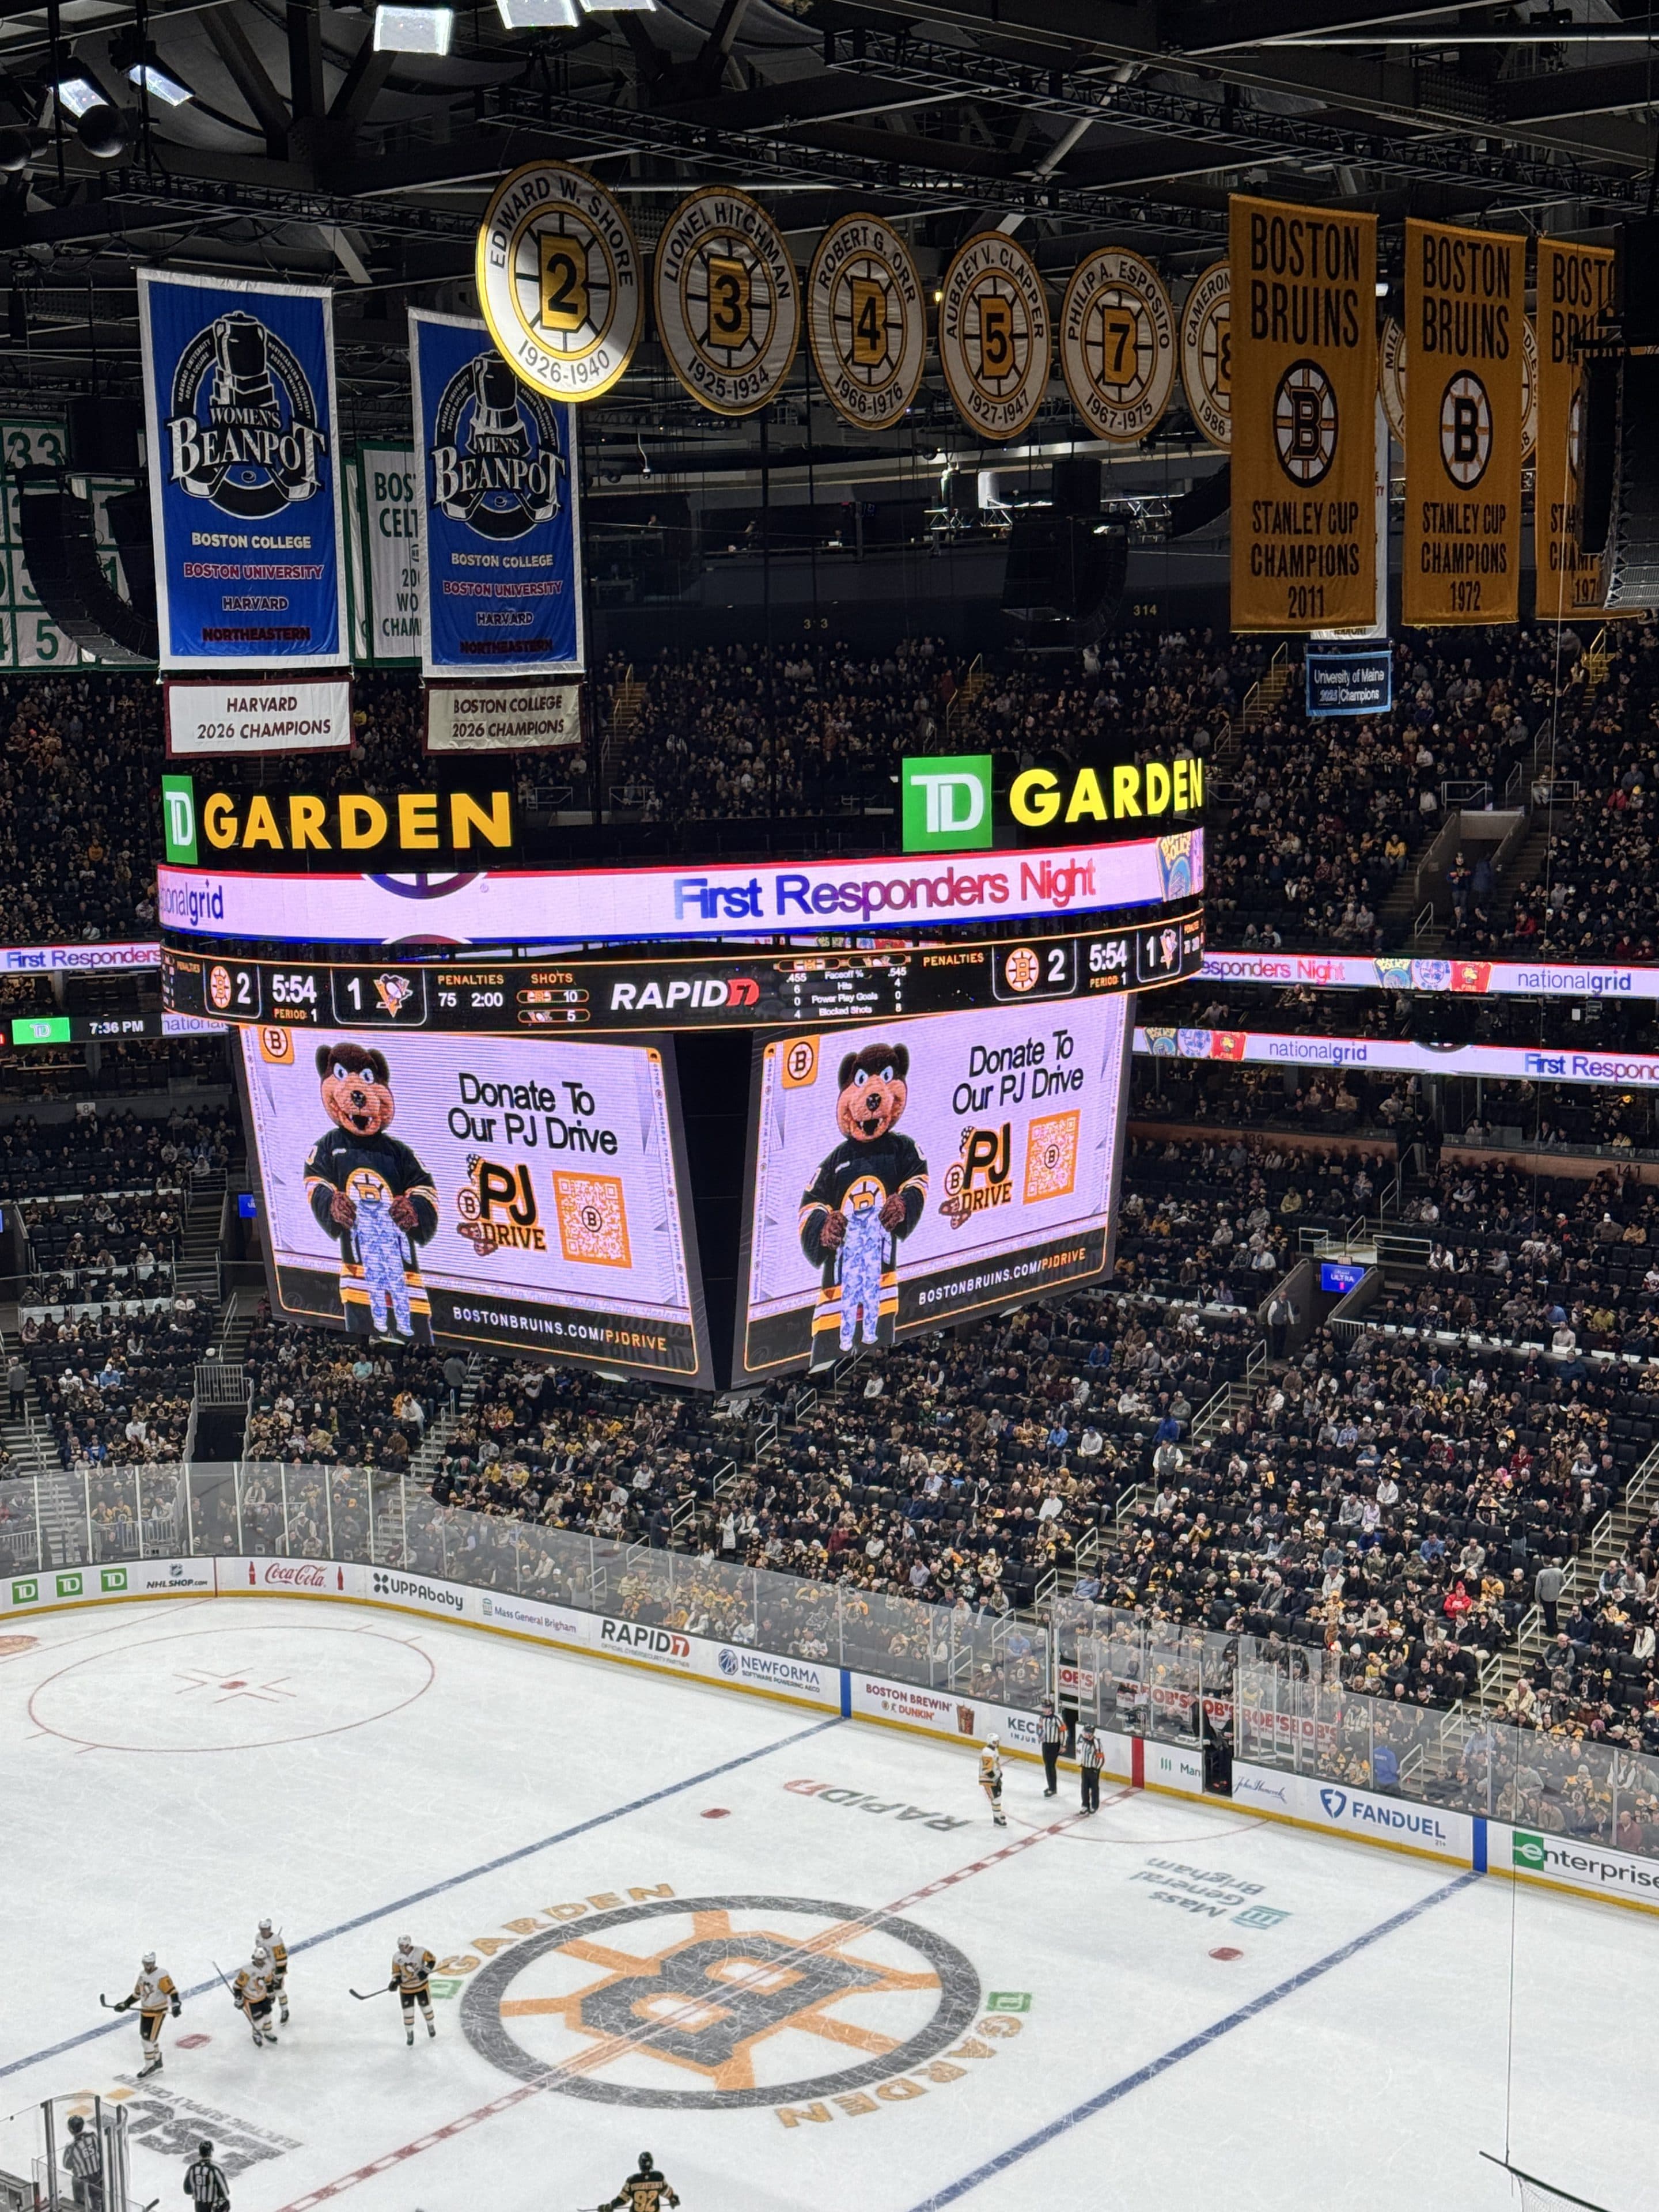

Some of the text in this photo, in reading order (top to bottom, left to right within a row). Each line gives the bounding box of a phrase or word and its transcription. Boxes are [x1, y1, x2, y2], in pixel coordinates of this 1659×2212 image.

[490, 176, 633, 287] EDWARD W. SHORE
[664, 203, 790, 299] LIONEL HITCHMAN
[1251, 213, 1359, 281] BOSTON
[819, 226, 915, 304] ROBERT G. ORR
[1423, 234, 1510, 299] BOSTON
[547, 253, 578, 315] 2
[946, 245, 1043, 340] AUBREY V. CLAPPER
[714, 275, 741, 332] 3
[1068, 260, 1169, 349] PHILIP A. ESPOSITO
[1251, 279, 1359, 349] BRUINS
[857, 297, 880, 351] 4
[986, 313, 1007, 363] 5
[1423, 296, 1509, 360] BRUINS
[518, 340, 609, 384] 1926-1940
[1109, 323, 1130, 372] 7
[687, 356, 769, 400] 1925-1934
[835, 374, 903, 415] 1966-1976
[968, 389, 1029, 423] 1927-1947
[210, 408, 281, 429] WOMEN'S
[1086, 393, 1152, 430] 1967-1975
[167, 416, 325, 486] BEANPOT
[477, 436, 519, 455] MEN'S
[432, 446, 565, 507] BEANPOT
[1252, 499, 1359, 535] STANLEY CUP
[1423, 502, 1506, 534] STANLEY CUP
[191, 532, 311, 549] BOSTON COLLEGE
[184, 563, 324, 580] BOSTON UNIVERSITY
[452, 553, 553, 568] BOSTON COLLEGE
[1251, 543, 1359, 578] CHAMPIONS
[1422, 541, 1506, 574] CHAMPIONS
[222, 596, 288, 611] HARVARD
[443, 580, 563, 597] BOSTON UNIVERSITY
[1288, 585, 1324, 619] 2011
[1450, 581, 1480, 612] 1972
[476, 612, 534, 626] HARVARD
[1133, 605, 1157, 616] 314
[202, 626, 310, 642] NORTHEASTERN
[460, 639, 552, 654] NORTHEASTERN
[1314, 668, 1384, 687] University of Maine
[227, 696, 297, 713] HARVARD
[454, 695, 562, 714] BOSTON COLLEGE
[1340, 688, 1380, 704] Champions
[197, 719, 331, 740] 2026 CHAMPIONS
[452, 719, 564, 738] 2026 CHAMPIONS
[911, 757, 1203, 833] TD GARDEN
[164, 791, 512, 849] TD GARDEN
[674, 858, 1096, 921] First Responders Night
[7, 947, 161, 969] First Responders
[923, 953, 984, 967] PENALTIES
[1048, 949, 1065, 982] 2
[1089, 940, 1127, 972] 5:54
[1146, 935, 1154, 967] 1
[438, 974, 504, 985] PENALTIES
[531, 973, 573, 984] SHOTS
[786, 973, 806, 983] .455
[825, 971, 853, 980] Faceoff
[888, 967, 907, 977] .545
[794, 978, 901, 994] 6 Hits 4
[1122, 972, 1126, 986] 1
[1297, 960, 1346, 985] Night
[1518, 969, 1631, 997] nationalgrid
[237, 972, 251, 1004] 2
[272, 974, 317, 1003] 5:54
[347, 978, 361, 1010] 1
[438, 993, 503, 1007] 75 2:00
[563, 991, 578, 1002] 10
[611, 977, 759, 1010] RAPID7
[794, 991, 902, 1006] 0 Power Play Goals 0
[311, 1009, 317, 1022] 1
[566, 1010, 575, 1022] 5
[794, 1003, 902, 1020] 4 Blocked Shots 8
[89, 1020, 143, 1035] 7:36 PM
[969, 1029, 1074, 1077] Donate To
[1269, 1039, 1368, 1067] nationalgrid
[1525, 1053, 1566, 1075] First
[459, 1073, 594, 1115] Donate To
[953, 1066, 1084, 1115] Our PJ Drive
[448, 1107, 618, 1155] Our PJ Drive
[964, 1122, 1011, 1190] PJ
[480, 1162, 536, 1226] PJ
[962, 1182, 1013, 1211] DRIVE
[482, 1223, 546, 1251] DRIVE
[919, 1248, 1086, 1305] BOSTONBRUINS.COM/PJDRIVE
[1331, 1274, 1355, 1283] ULTRA
[453, 1306, 667, 1352] BOSTONBRUINS.COM/PJDRIVE
[59, 1577, 79, 1592] TD
[103, 1572, 124, 1587] TD
[265, 1563, 326, 1588] Coca-Cola
[14, 1584, 35, 1599] TD
[391, 1578, 464, 1611] UPPAbaby
[495, 1606, 577, 1634] Mass General Brigham
[601, 1619, 690, 1657] RAPID7
[741, 1655, 819, 1685] NEWFORMA
[742, 1671, 820, 1693] SOFTWARE POWERING AECO
[866, 1684, 952, 1712] BOSTON BREWIN'
[899, 1706, 934, 1721] DUNKIN'
[1243, 1709, 1289, 1732] BOB'S
[1353, 1802, 1446, 1839] FANDUEL
[1129, 1871, 1244, 1906] General
[1146, 1858, 1266, 1896] Brigham
[1149, 1892, 1227, 1918] Mass
[442, 1883, 675, 1977] GARDEN
[775, 2014, 1024, 2128] GARDEN
[170, 2096, 230, 2122] SUPPLY
[634, 2191, 658, 2212] 92
